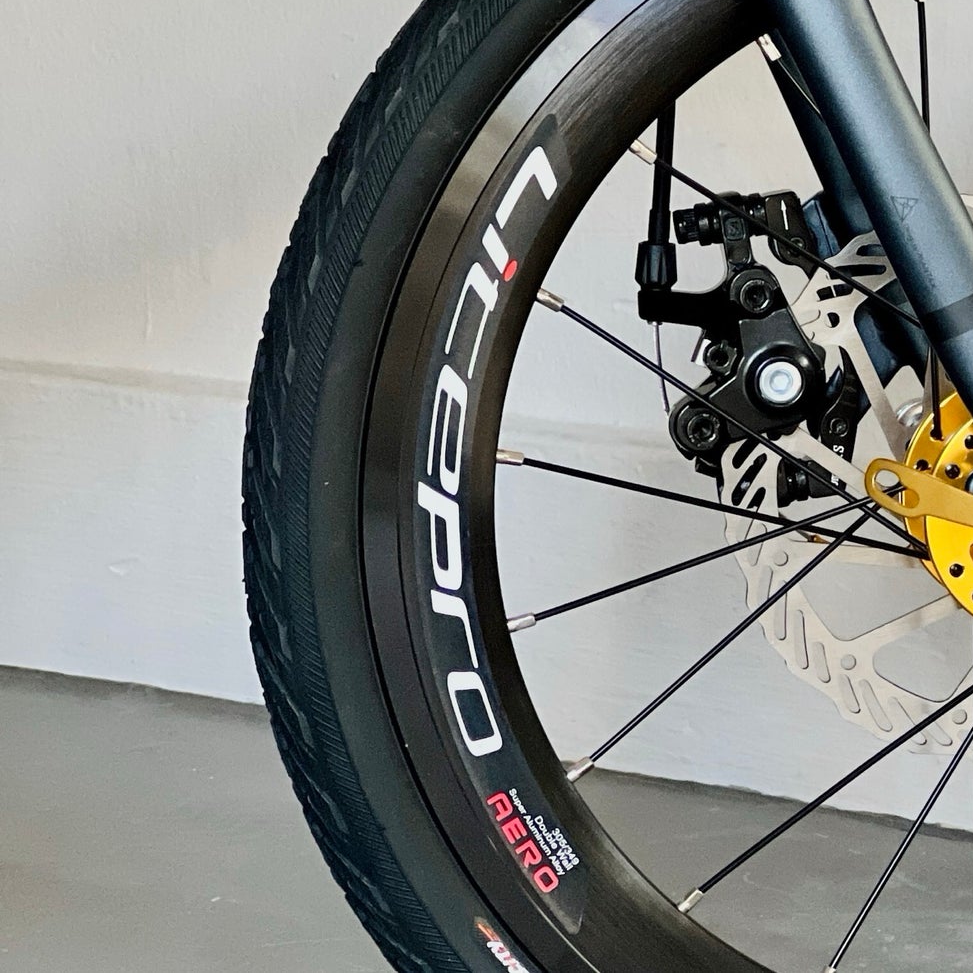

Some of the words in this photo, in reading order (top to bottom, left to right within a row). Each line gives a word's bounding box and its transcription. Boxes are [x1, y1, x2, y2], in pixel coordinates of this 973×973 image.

[418, 146, 558, 757] Litepro
[486, 791, 560, 894] AERO
[508, 787, 527, 815] Super
[522, 812, 552, 855] Aluminum
[547, 854, 566, 876] Alloy
[534, 814, 559, 850] Double
[555, 848, 575, 872] Wall
[551, 827, 580, 867] 305/349
